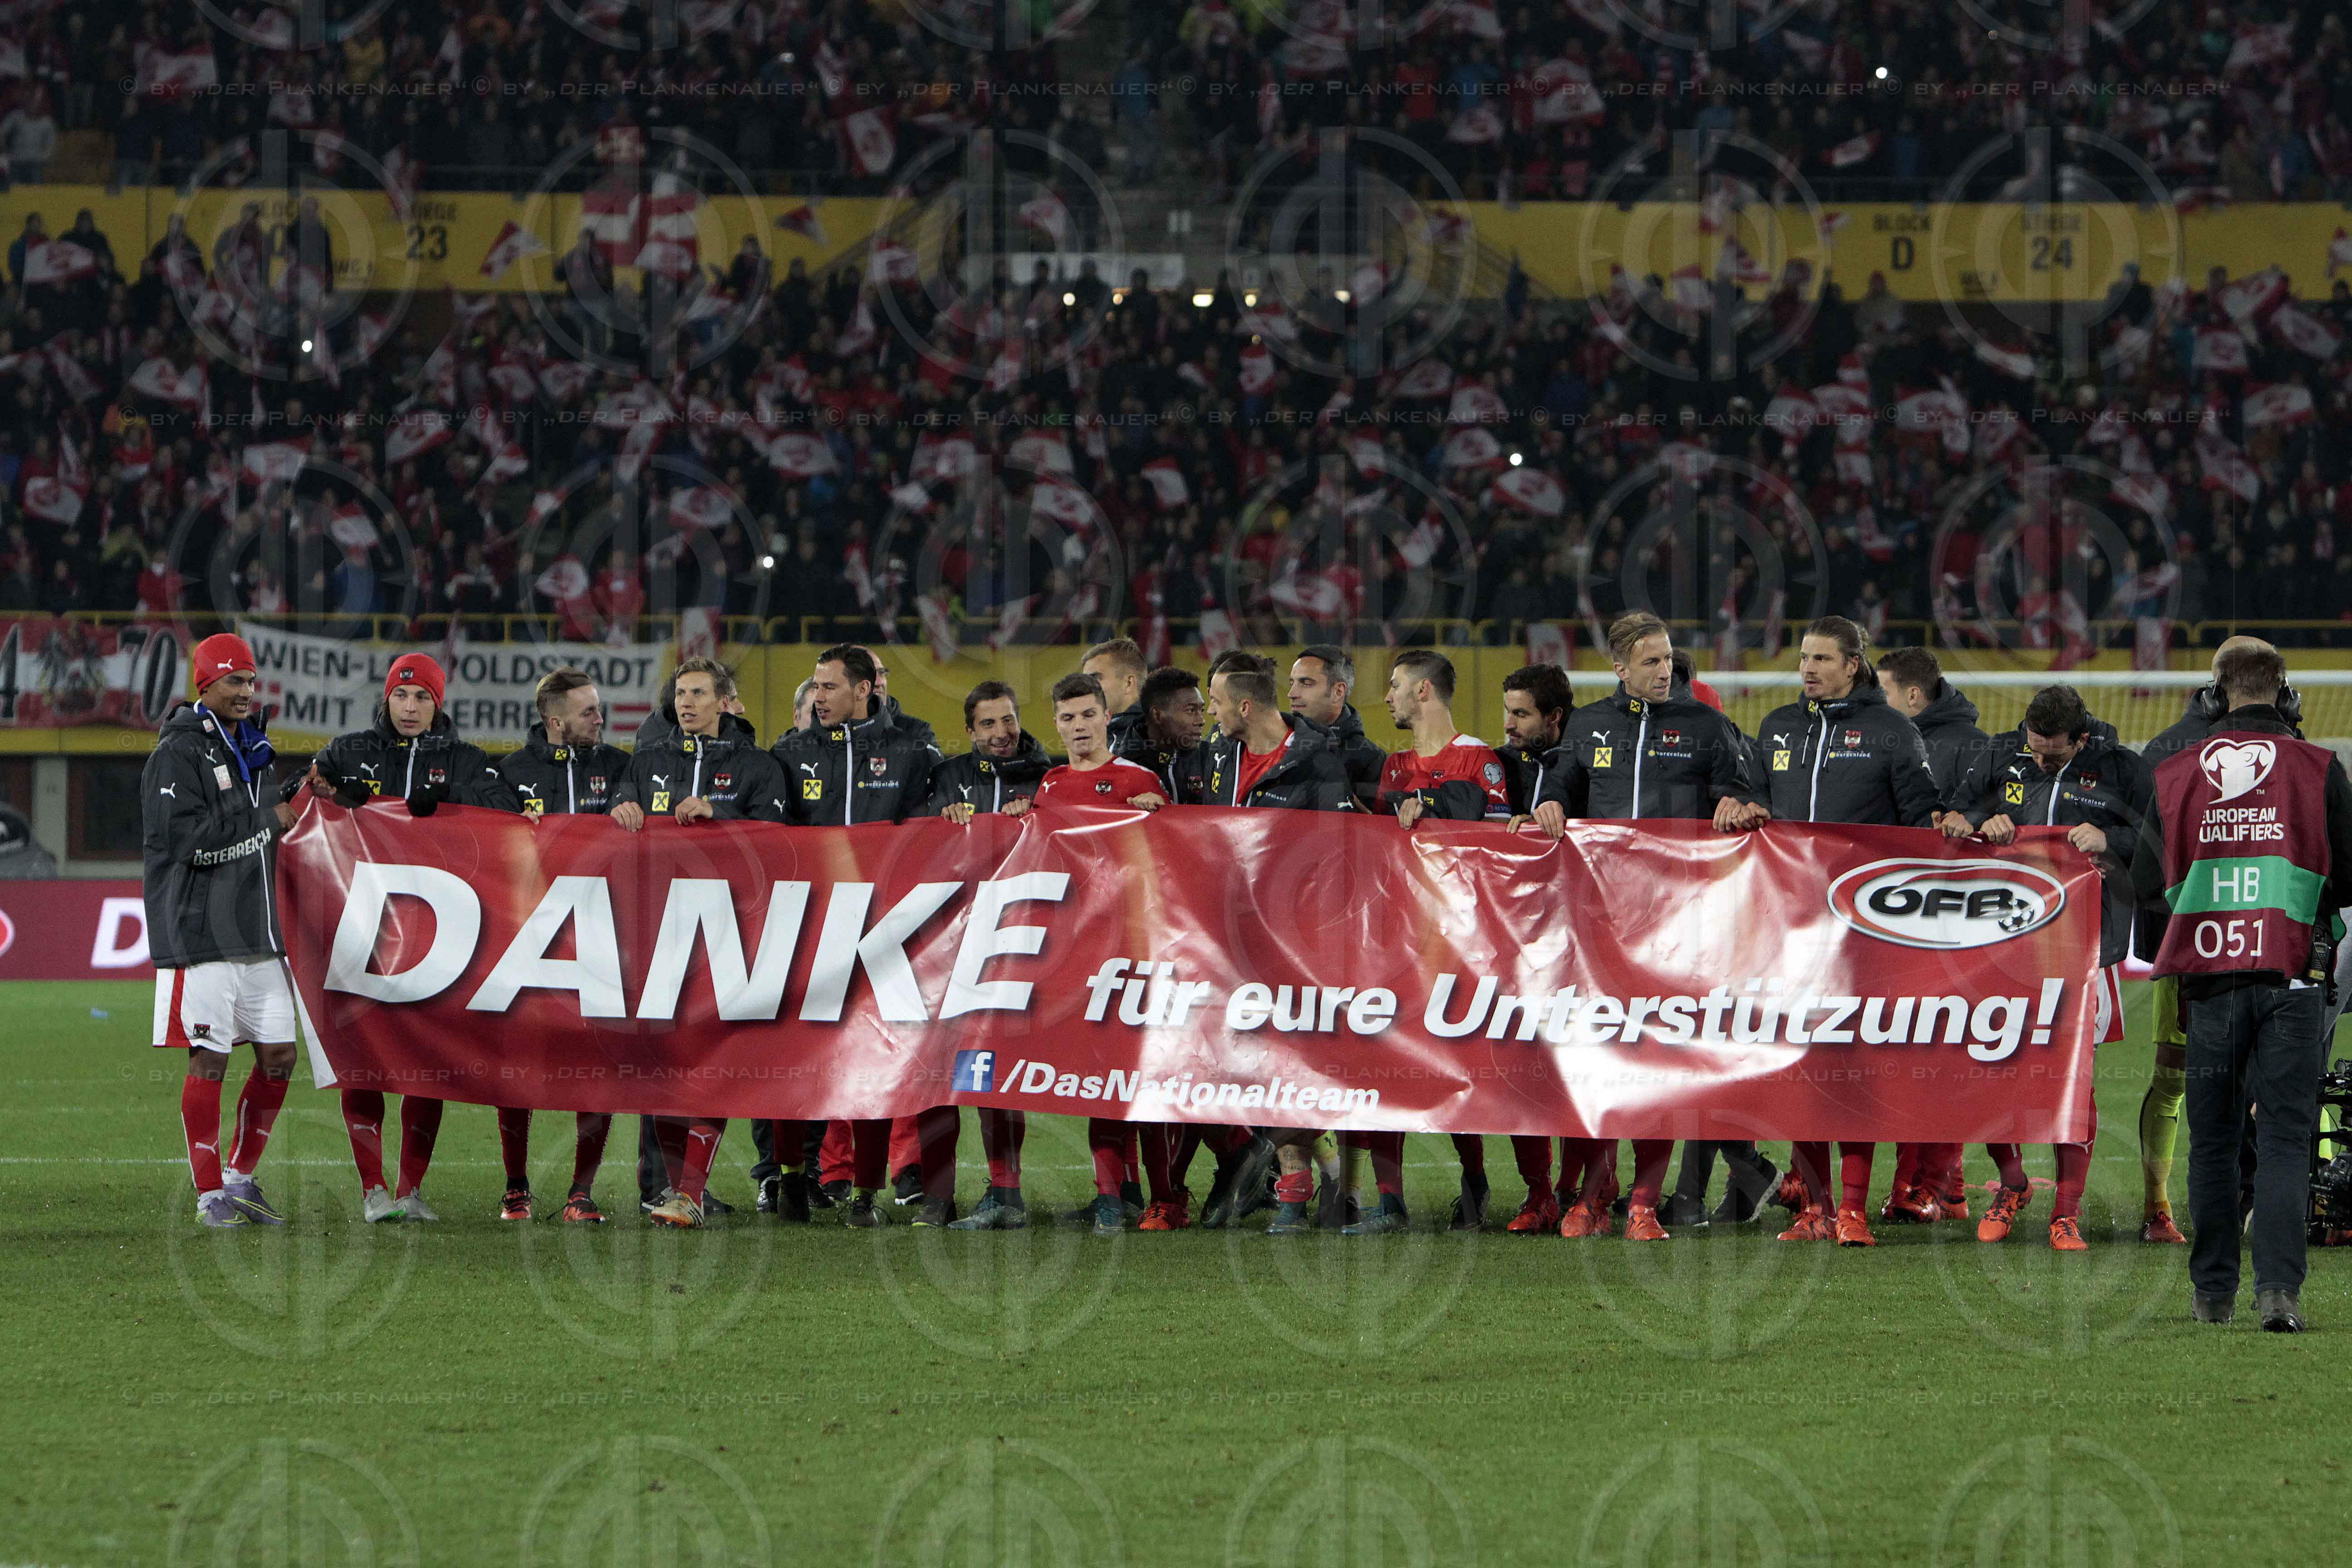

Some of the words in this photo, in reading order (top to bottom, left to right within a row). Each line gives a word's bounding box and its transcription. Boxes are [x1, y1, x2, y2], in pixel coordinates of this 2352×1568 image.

[407, 225, 447, 260] 23
[1891, 236, 1914, 271] D
[2031, 236, 2072, 270] 24
[284, 690, 354, 727] MIT
[2200, 823, 2284, 843] UALIFIERS
[2202, 807, 2276, 824] UROPEAN
[193, 827, 271, 866] ÖSTERREICH
[2213, 867, 2260, 902] HB
[323, 860, 1070, 1022] DANKE
[1083, 957, 1210, 1026] für
[1225, 981, 1397, 1034] eure
[1423, 973, 2064, 1062] Unterstützung!
[999, 1058, 1380, 1111] /DasNationalteam
